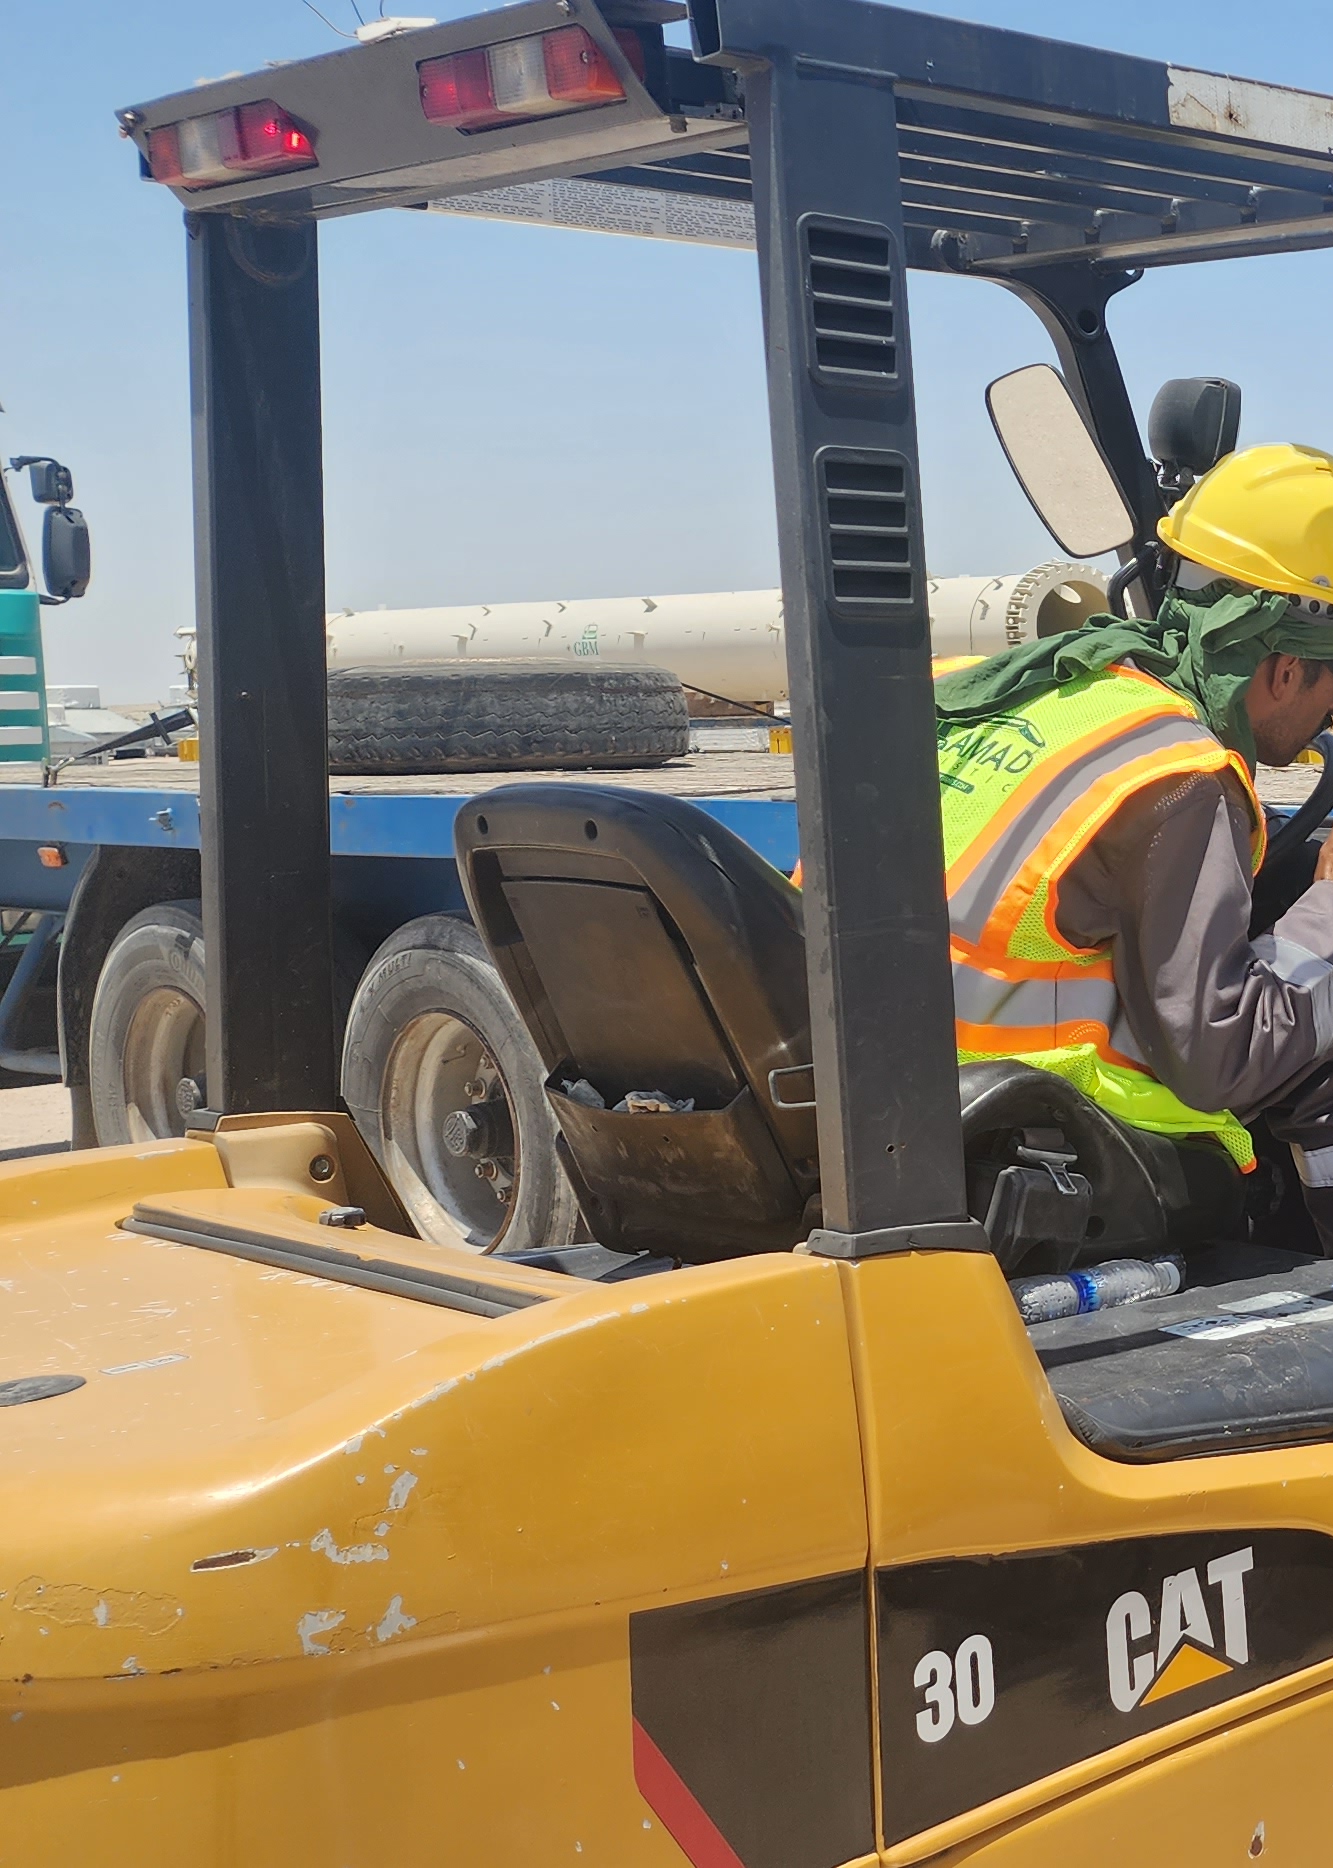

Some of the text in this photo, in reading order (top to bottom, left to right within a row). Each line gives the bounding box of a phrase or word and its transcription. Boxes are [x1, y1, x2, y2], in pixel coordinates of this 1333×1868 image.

[573, 641, 600, 657] GBM
[938, 730, 1034, 774] AMAD
[1105, 1545, 1255, 1713] CAT
[913, 1634, 995, 1743] 30
